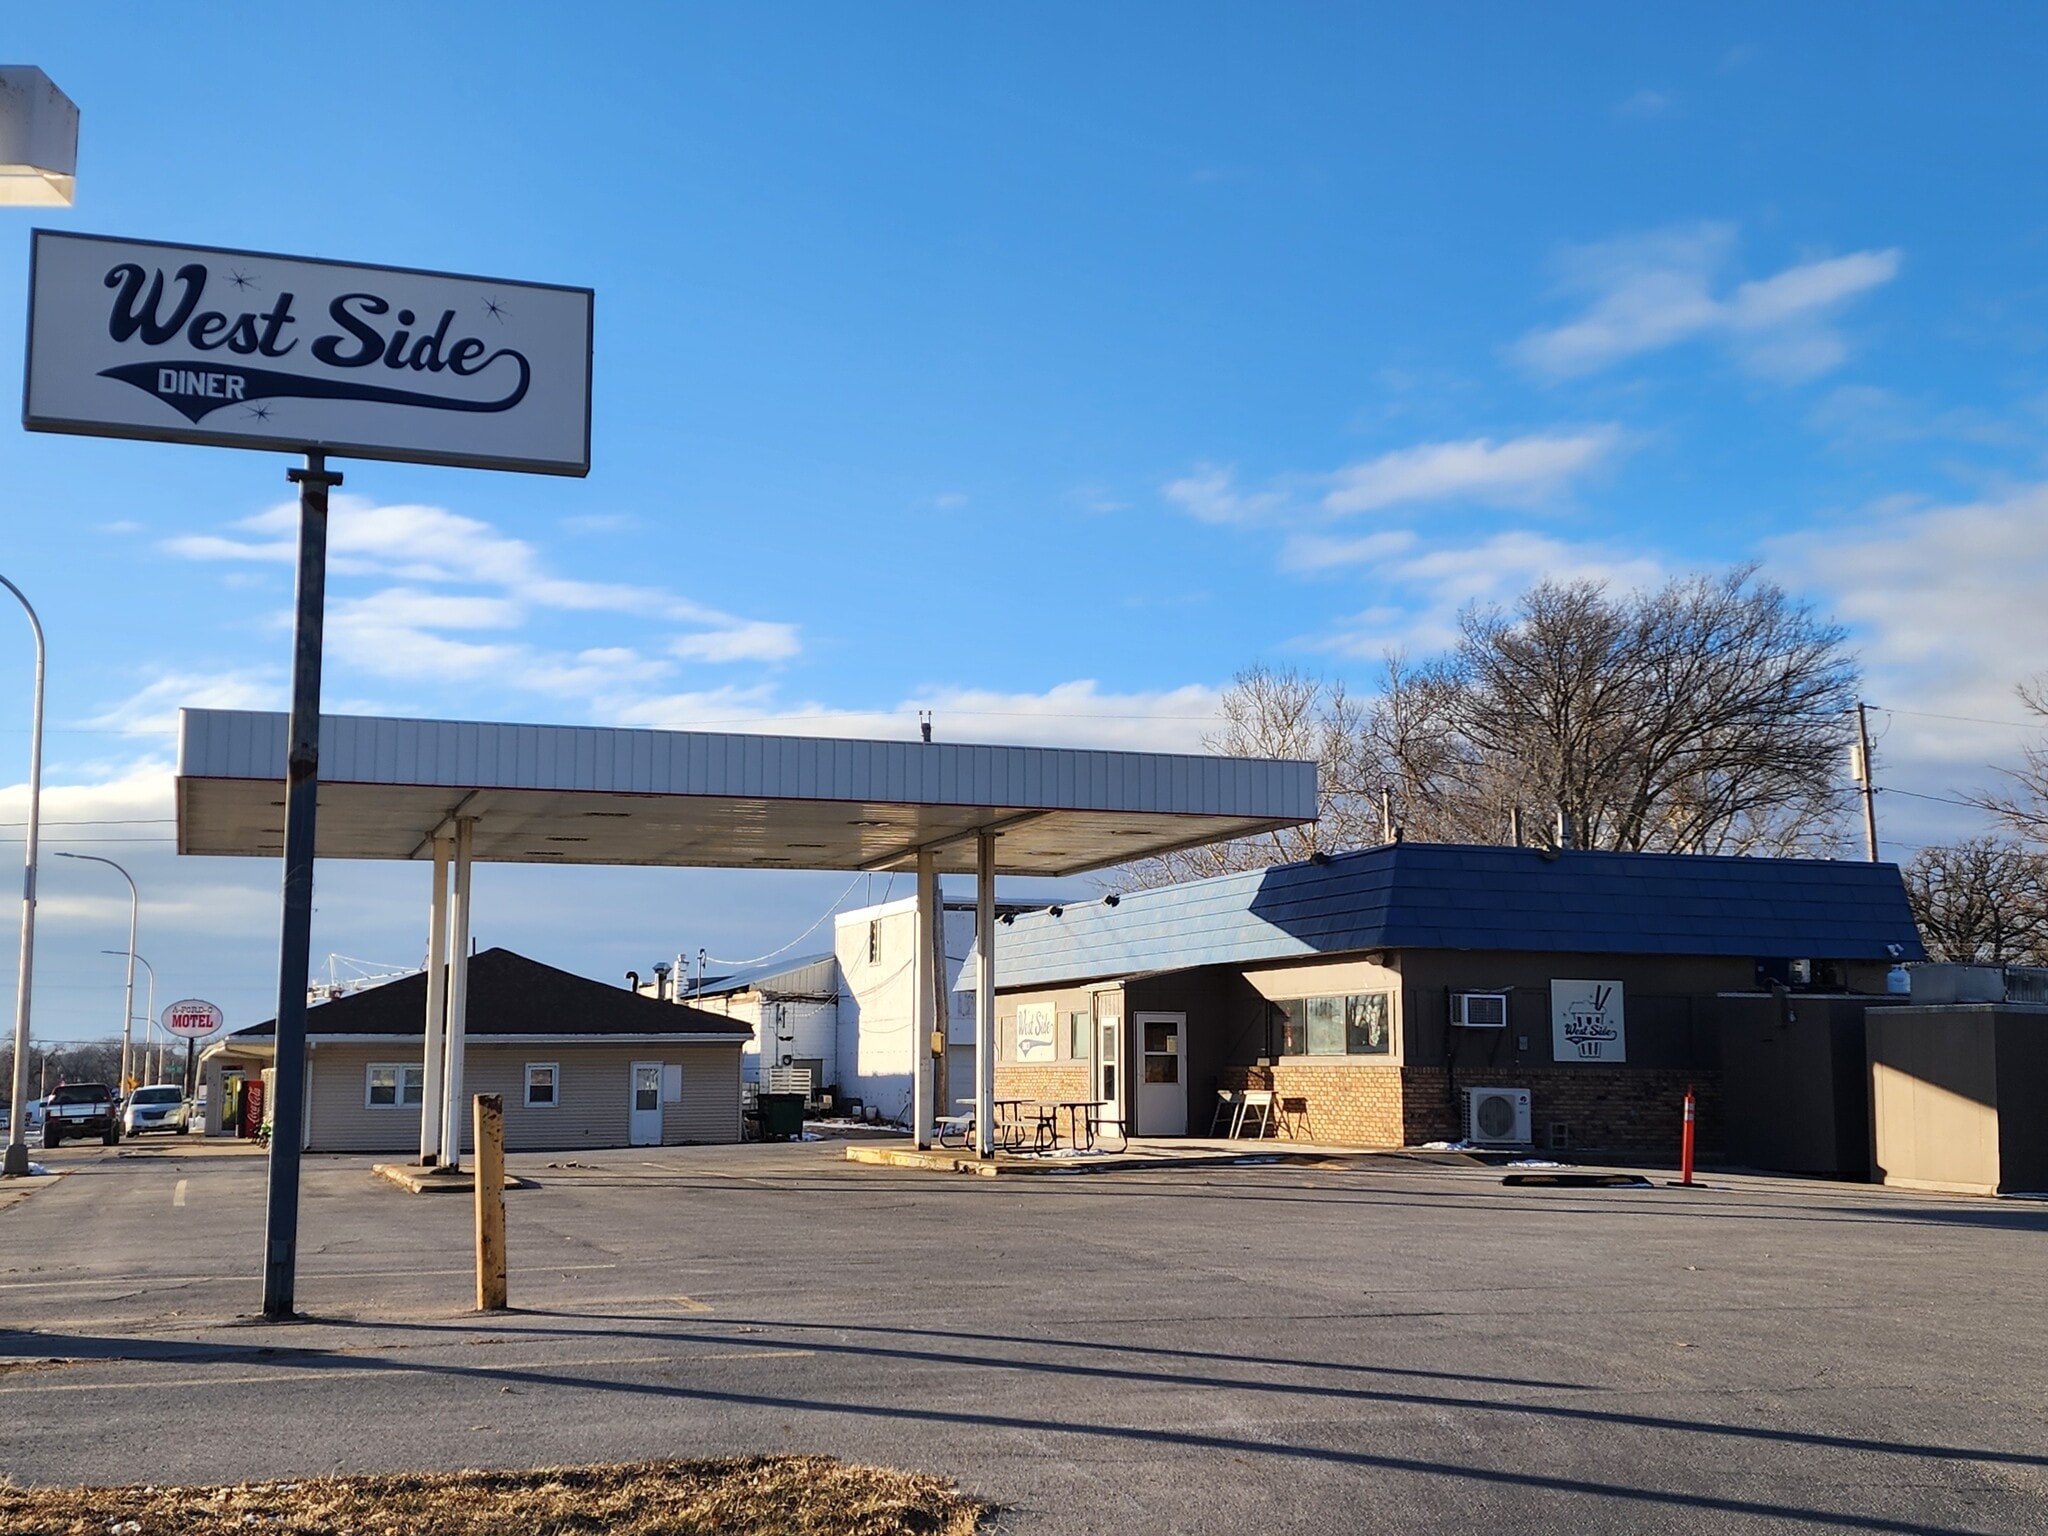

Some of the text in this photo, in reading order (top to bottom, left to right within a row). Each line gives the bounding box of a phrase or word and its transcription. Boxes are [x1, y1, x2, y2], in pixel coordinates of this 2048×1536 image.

[104, 262, 512, 377] West Side
[157, 367, 246, 401] DINER
[171, 1014, 214, 1028] MOTEL
[1564, 1022, 1613, 1037] West Side
